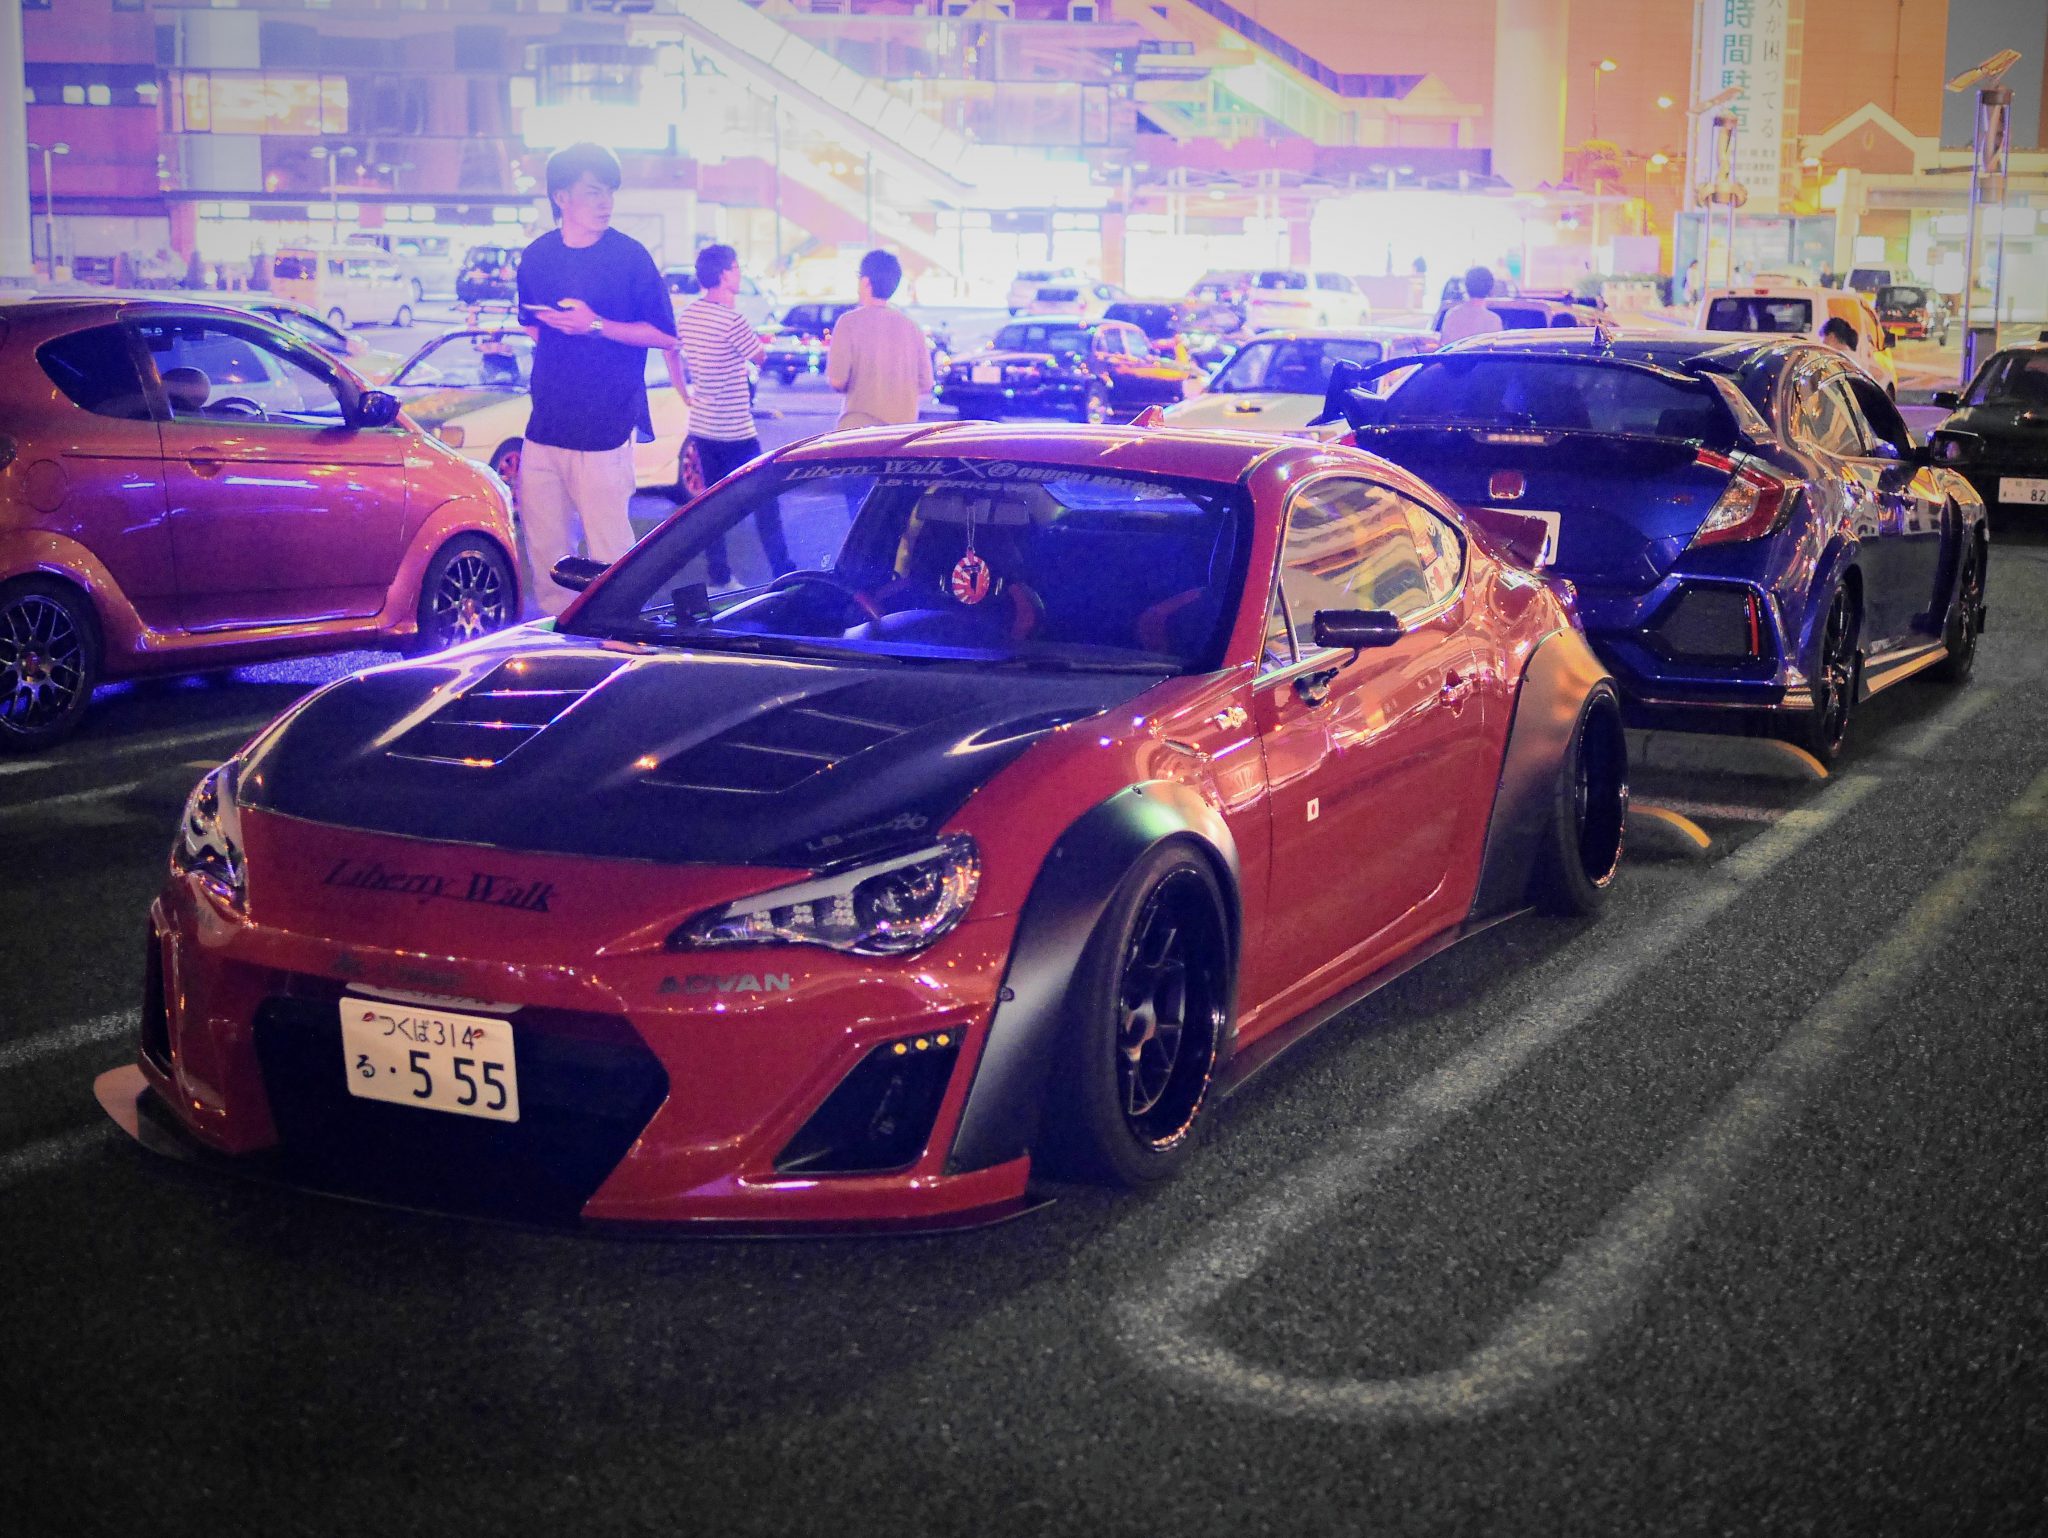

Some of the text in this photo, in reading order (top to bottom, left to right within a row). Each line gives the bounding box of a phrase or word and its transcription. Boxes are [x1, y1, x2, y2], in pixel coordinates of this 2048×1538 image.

[785, 464, 879, 481] Liberty
[883, 460, 946, 475] Walk
[322, 857, 558, 913] Liberty Walk
[656, 972, 792, 994] ADVAN
[356, 1054, 376, 1079] る
